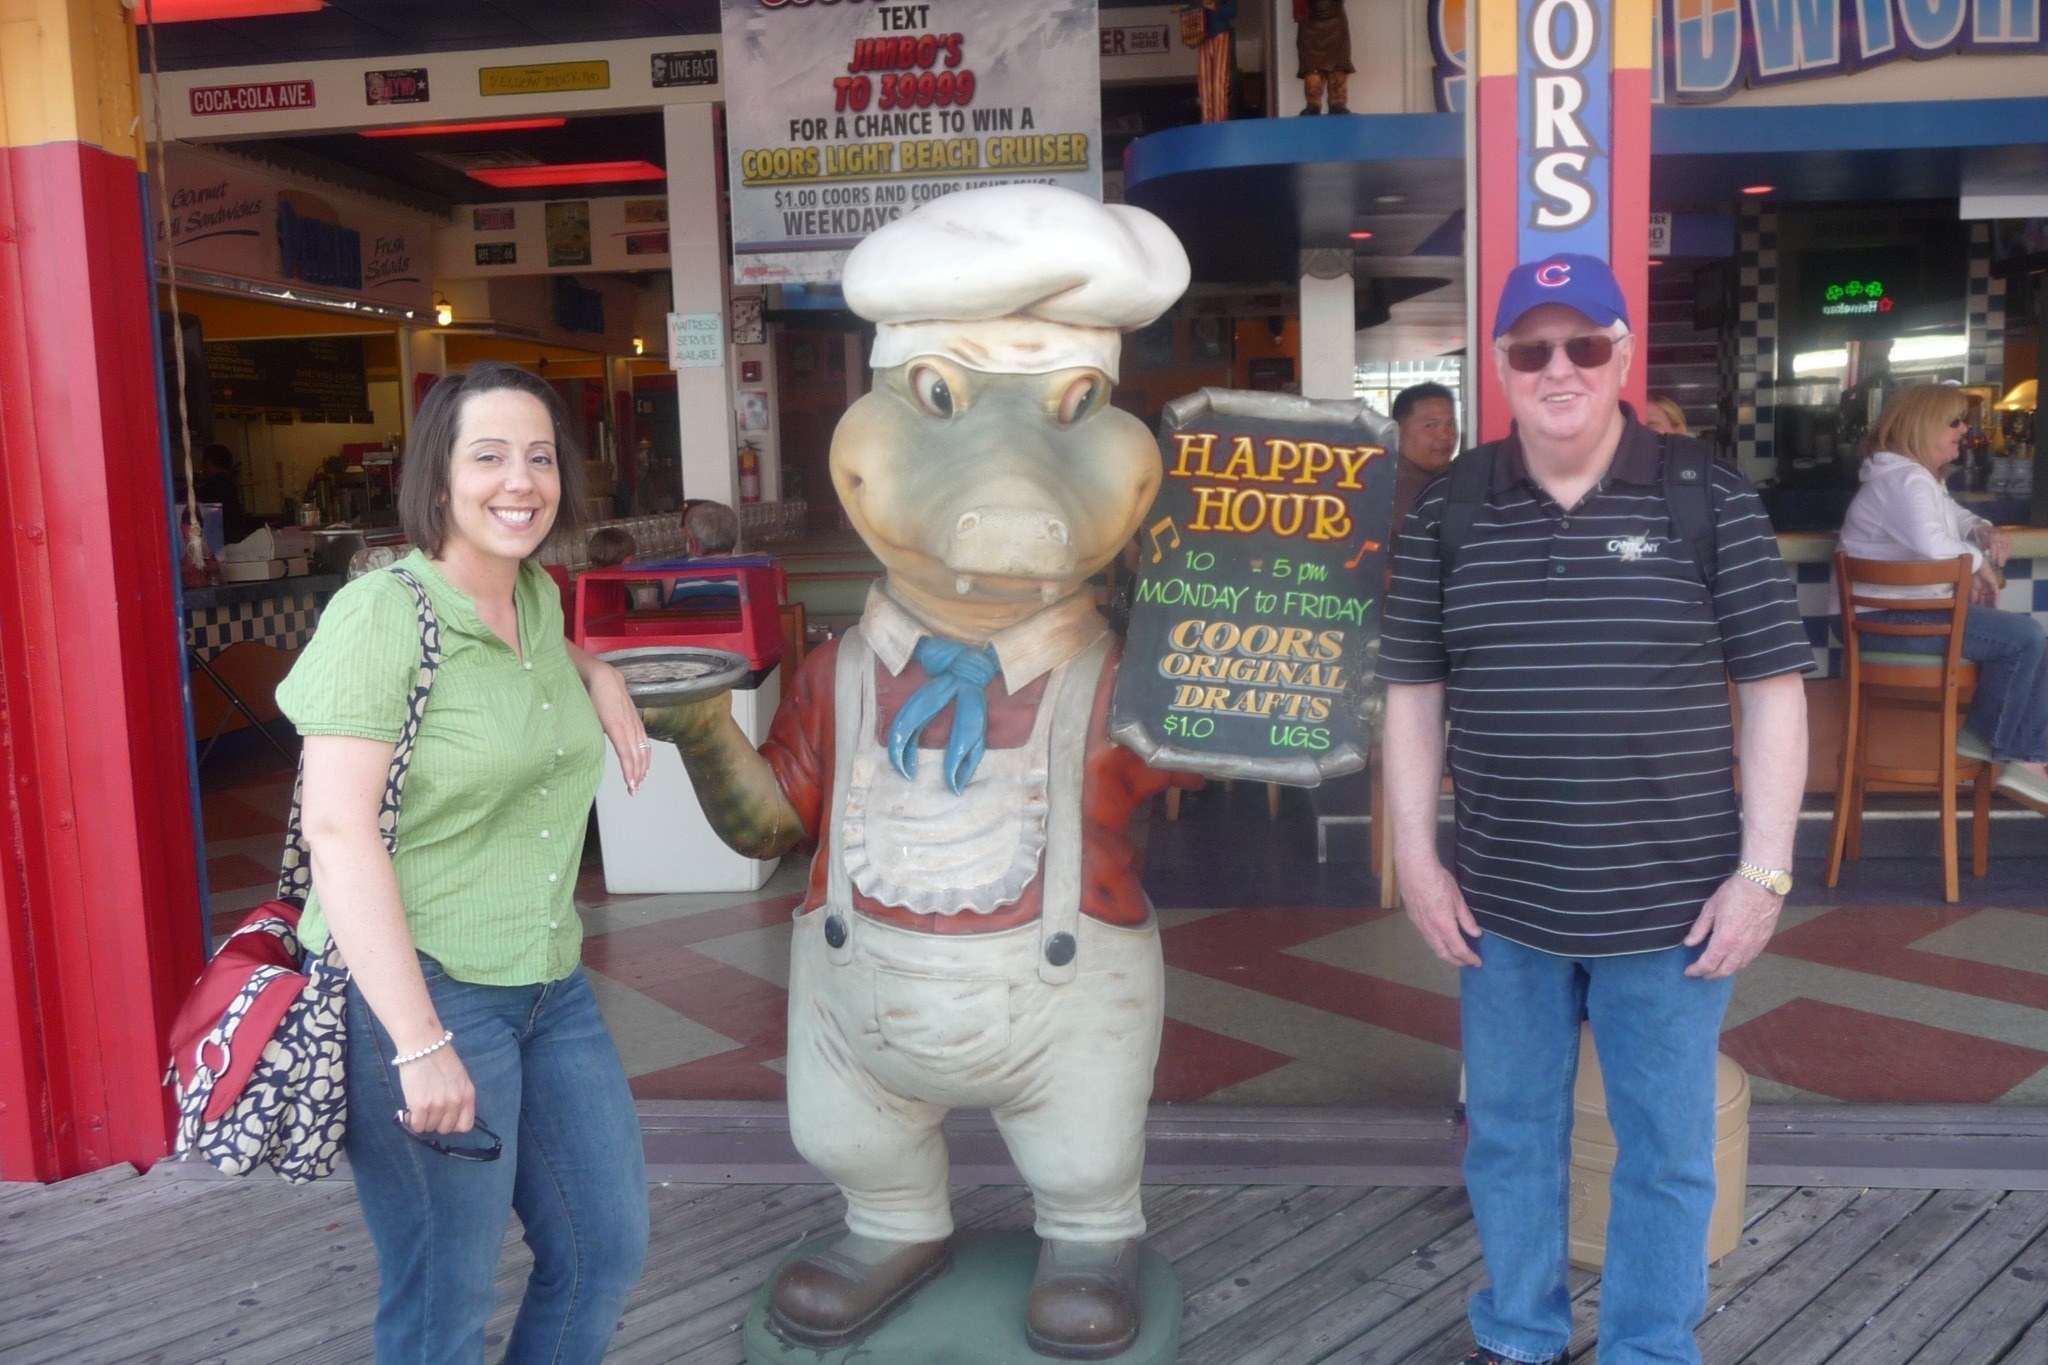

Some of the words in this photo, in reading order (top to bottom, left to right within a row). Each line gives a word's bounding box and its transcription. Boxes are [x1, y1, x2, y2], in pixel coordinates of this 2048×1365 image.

[879, 5, 930, 30] TEXT
[1131, 31, 1159, 40] SOLD
[848, 33, 964, 72] JIMBO'S
[669, 60, 690, 79] LIVE
[692, 58, 714, 77] FAST
[194, 87, 275, 112] COCA-COLA
[279, 84, 311, 106] AVE.
[834, 76, 872, 111] TO
[878, 70, 976, 109] 39999
[790, 118, 828, 141] FOR
[834, 117, 849, 138] A
[854, 112, 932, 138] CHANCE
[938, 110, 965, 133] TO
[972, 108, 1014, 132] WIN
[1020, 107, 1035, 129] A
[742, 148, 820, 178] COORS
[826, 143, 894, 173] LIGHT
[901, 138, 979, 168] BEACH
[985, 133, 1089, 164] CRUISER
[172, 180, 230, 209] Gourmet
[774, 188, 817, 209] $1.00
[822, 186, 869, 206] COORS
[875, 184, 907, 204] AND
[185, 200, 262, 232] Sandwiches
[783, 206, 902, 237] WEEKDAYS
[1536, 261, 1571, 287] C
[672, 319, 718, 331] WAITRESS
[677, 334, 714, 346] SERVICE
[676, 349, 717, 361] AVAILABLE
[1168, 431, 1386, 490] HAPPY
[1188, 486, 1353, 541] HOUR
[1186, 551, 1216, 571] 10
[1272, 558, 1292, 578] 5
[1297, 562, 1328, 586] pm
[1136, 578, 1250, 614] MONDAY
[1255, 591, 1278, 614] to
[1283, 592, 1374, 626] FRIDAY
[1168, 619, 1345, 662] COORS
[1159, 652, 1347, 693] ORIGINAL
[1169, 684, 1332, 723] DRAFTS
[1270, 725, 1331, 750] UGS
